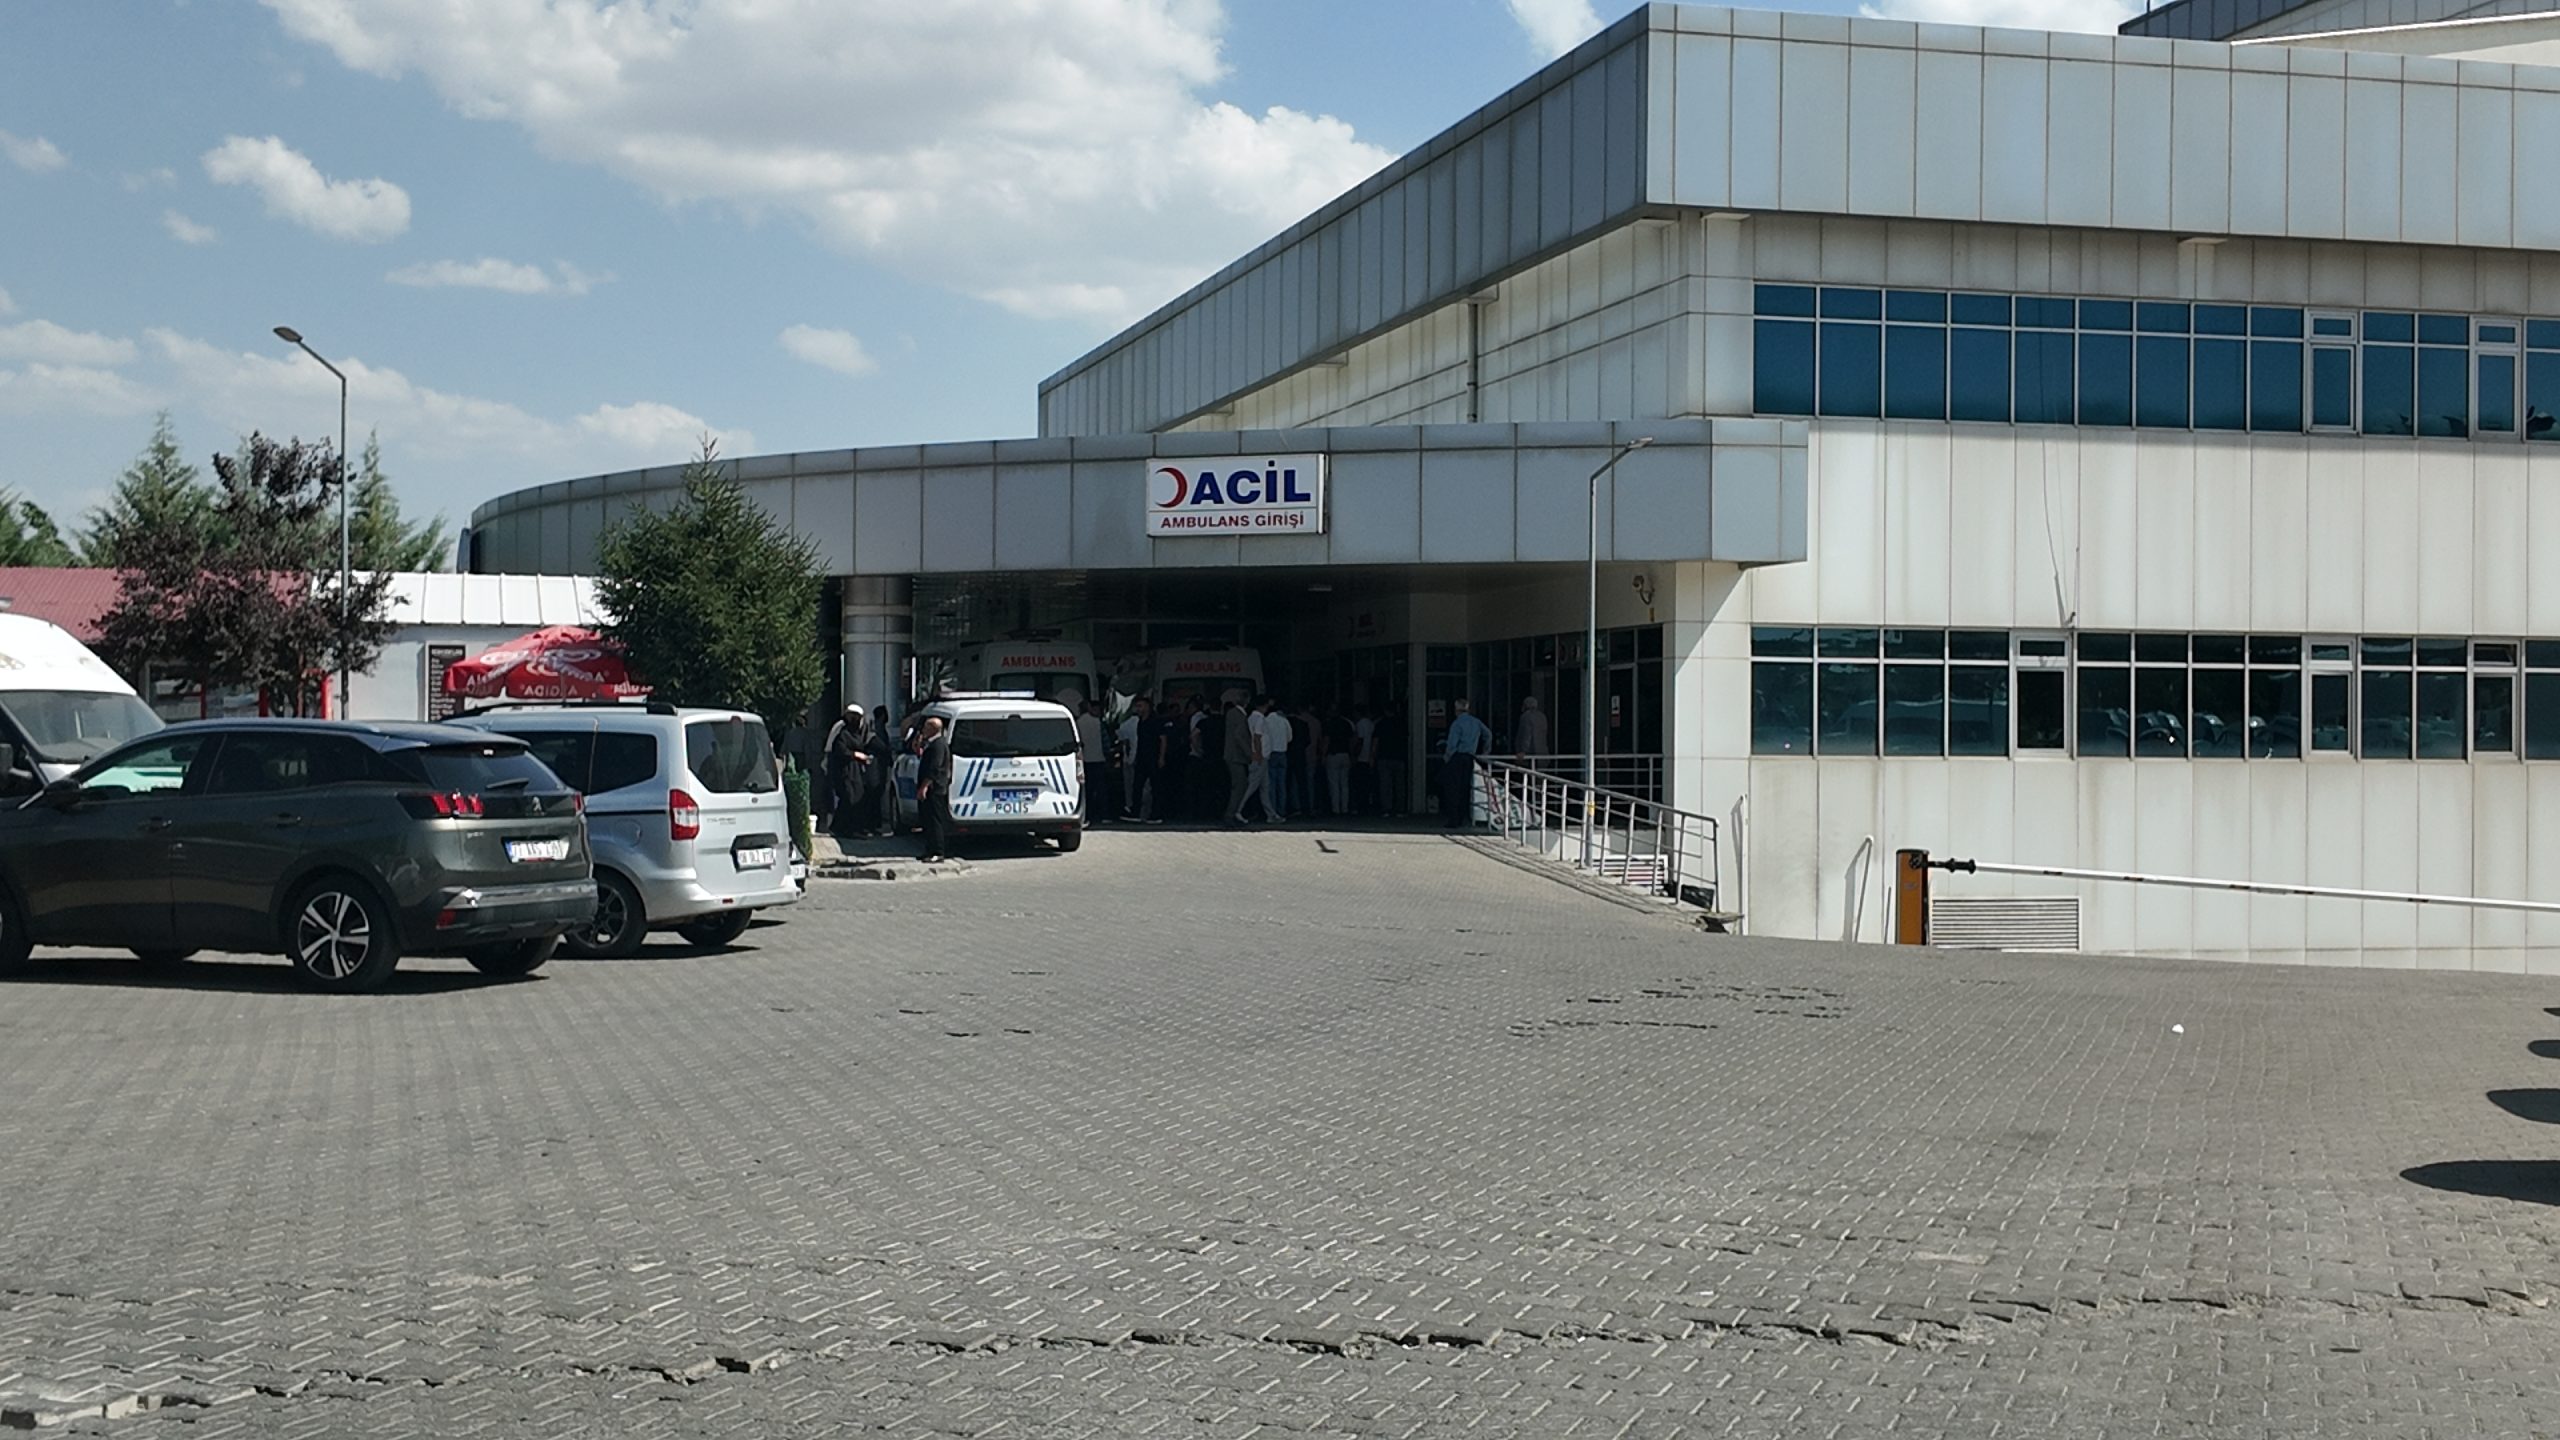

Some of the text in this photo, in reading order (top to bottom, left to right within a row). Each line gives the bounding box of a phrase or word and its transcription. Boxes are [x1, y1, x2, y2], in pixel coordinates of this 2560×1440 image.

[1190, 460, 1311, 505] ACİL
[1160, 511, 1304, 529] AMBULANS GİRİŞİ
[1001, 655, 1077, 668] AMBULANS
[1174, 661, 1242, 674] AMBULANS
